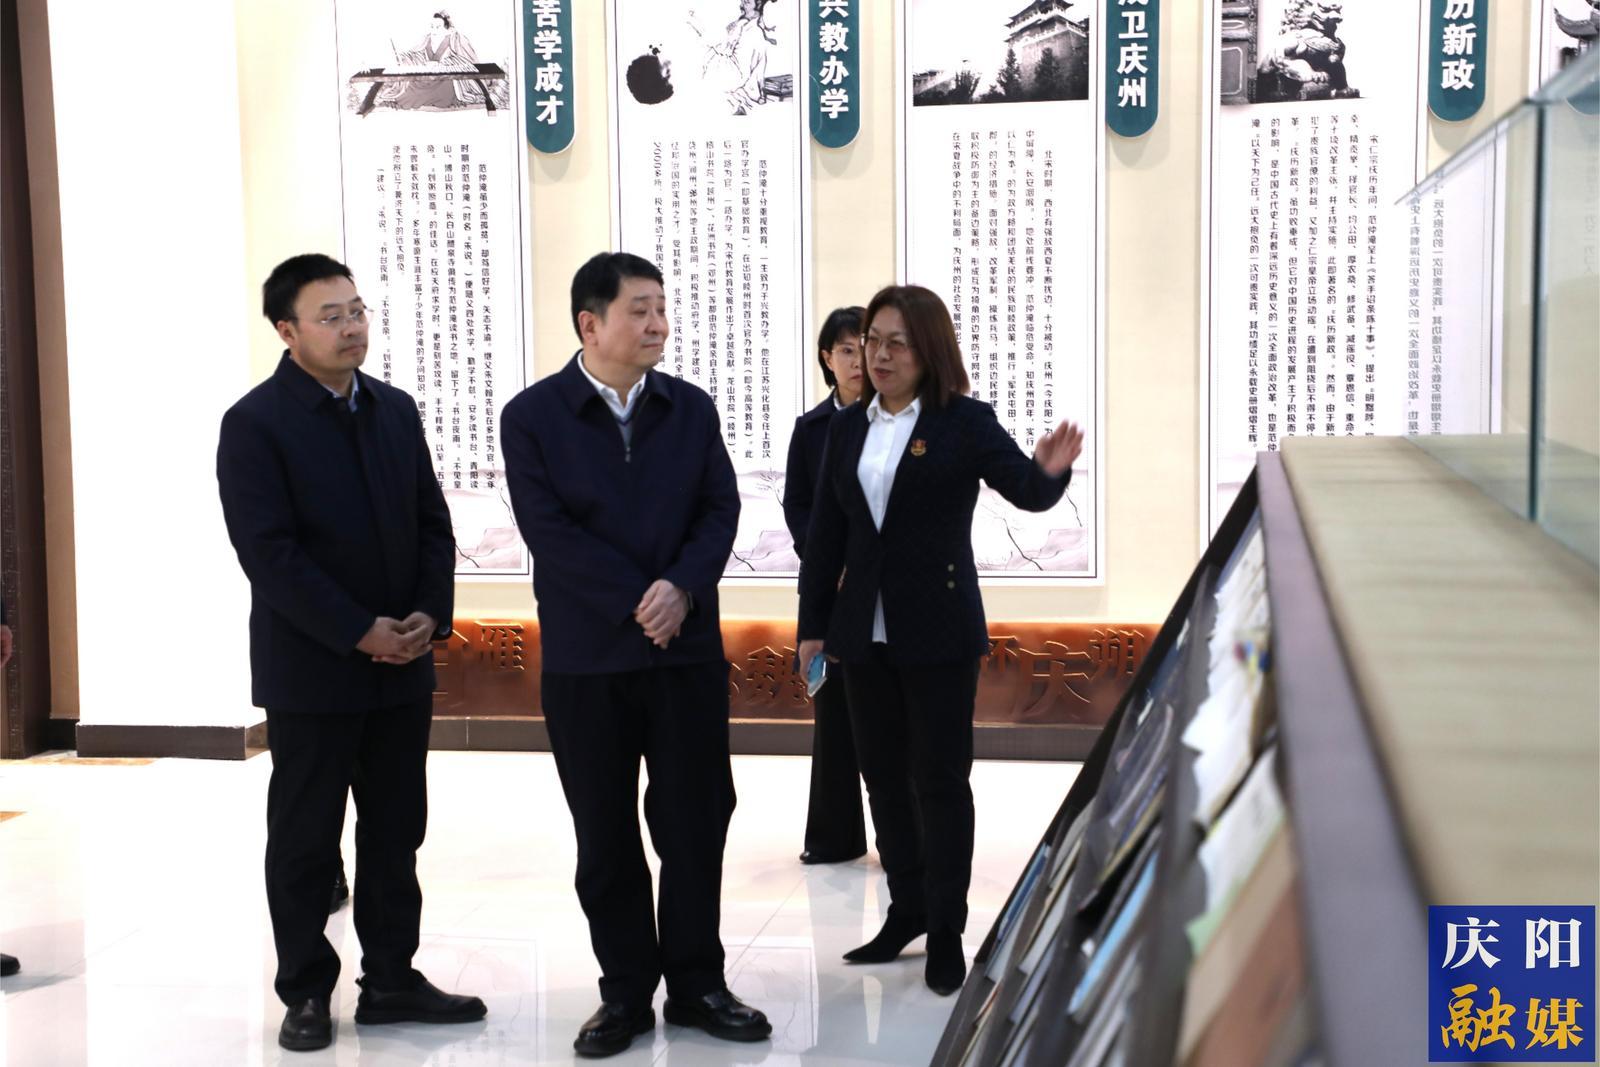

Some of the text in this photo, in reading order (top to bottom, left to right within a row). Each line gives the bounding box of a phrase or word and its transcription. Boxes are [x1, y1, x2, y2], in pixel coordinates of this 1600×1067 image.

[532, 0, 564, 125] 苦学成才
[1117, 0, 1149, 108] 卫庆州
